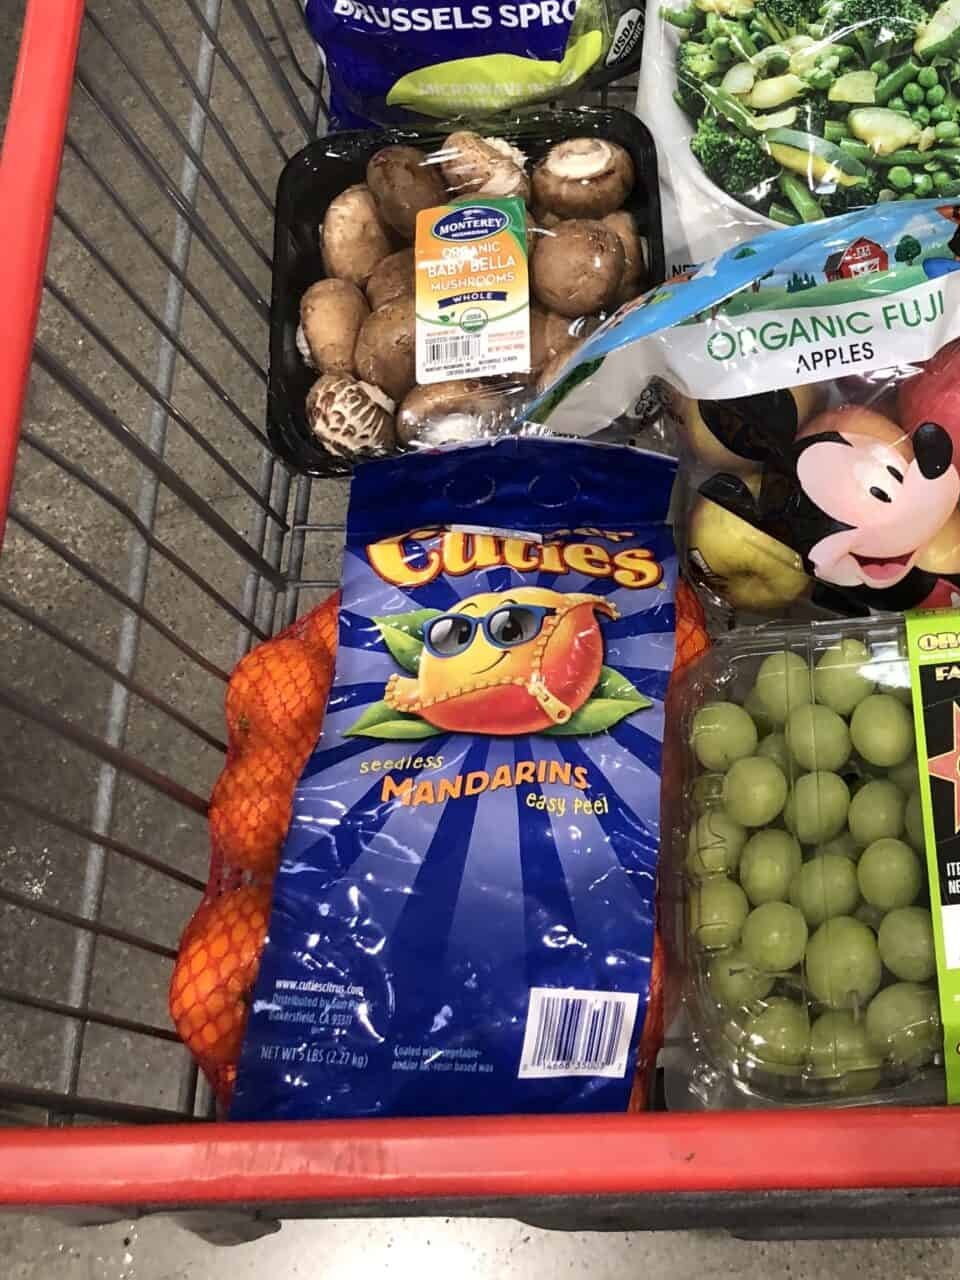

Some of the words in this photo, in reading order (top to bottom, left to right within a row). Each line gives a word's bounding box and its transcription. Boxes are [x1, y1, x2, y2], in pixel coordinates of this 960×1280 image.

[440, 217, 503, 235] MONTEREY
[441, 241, 501, 258] ORGANIC
[427, 260, 466, 278] BABY
[470, 255, 516, 273] BELLA
[431, 271, 515, 292] MUSHROOMS
[452, 292, 494, 303] WHOLE
[707, 311, 873, 362] ORGANIC
[882, 290, 945, 332] FUJI
[795, 341, 875, 374] APPLES
[366, 525, 665, 588] Cuties
[360, 754, 444, 774] seedless
[381, 759, 592, 807] MANDARINS
[526, 791, 566, 816] easy
[275, 979, 365, 996] www.cutiescitrus.com
[260, 1045, 280, 1061] NET
[282, 1047, 297, 1061] WT
[299, 1050, 305, 1061] 5
[306, 1048, 324, 1062] LBS
[326, 1050, 351, 1065] (2.27
[351, 1053, 369, 1071] kg)
